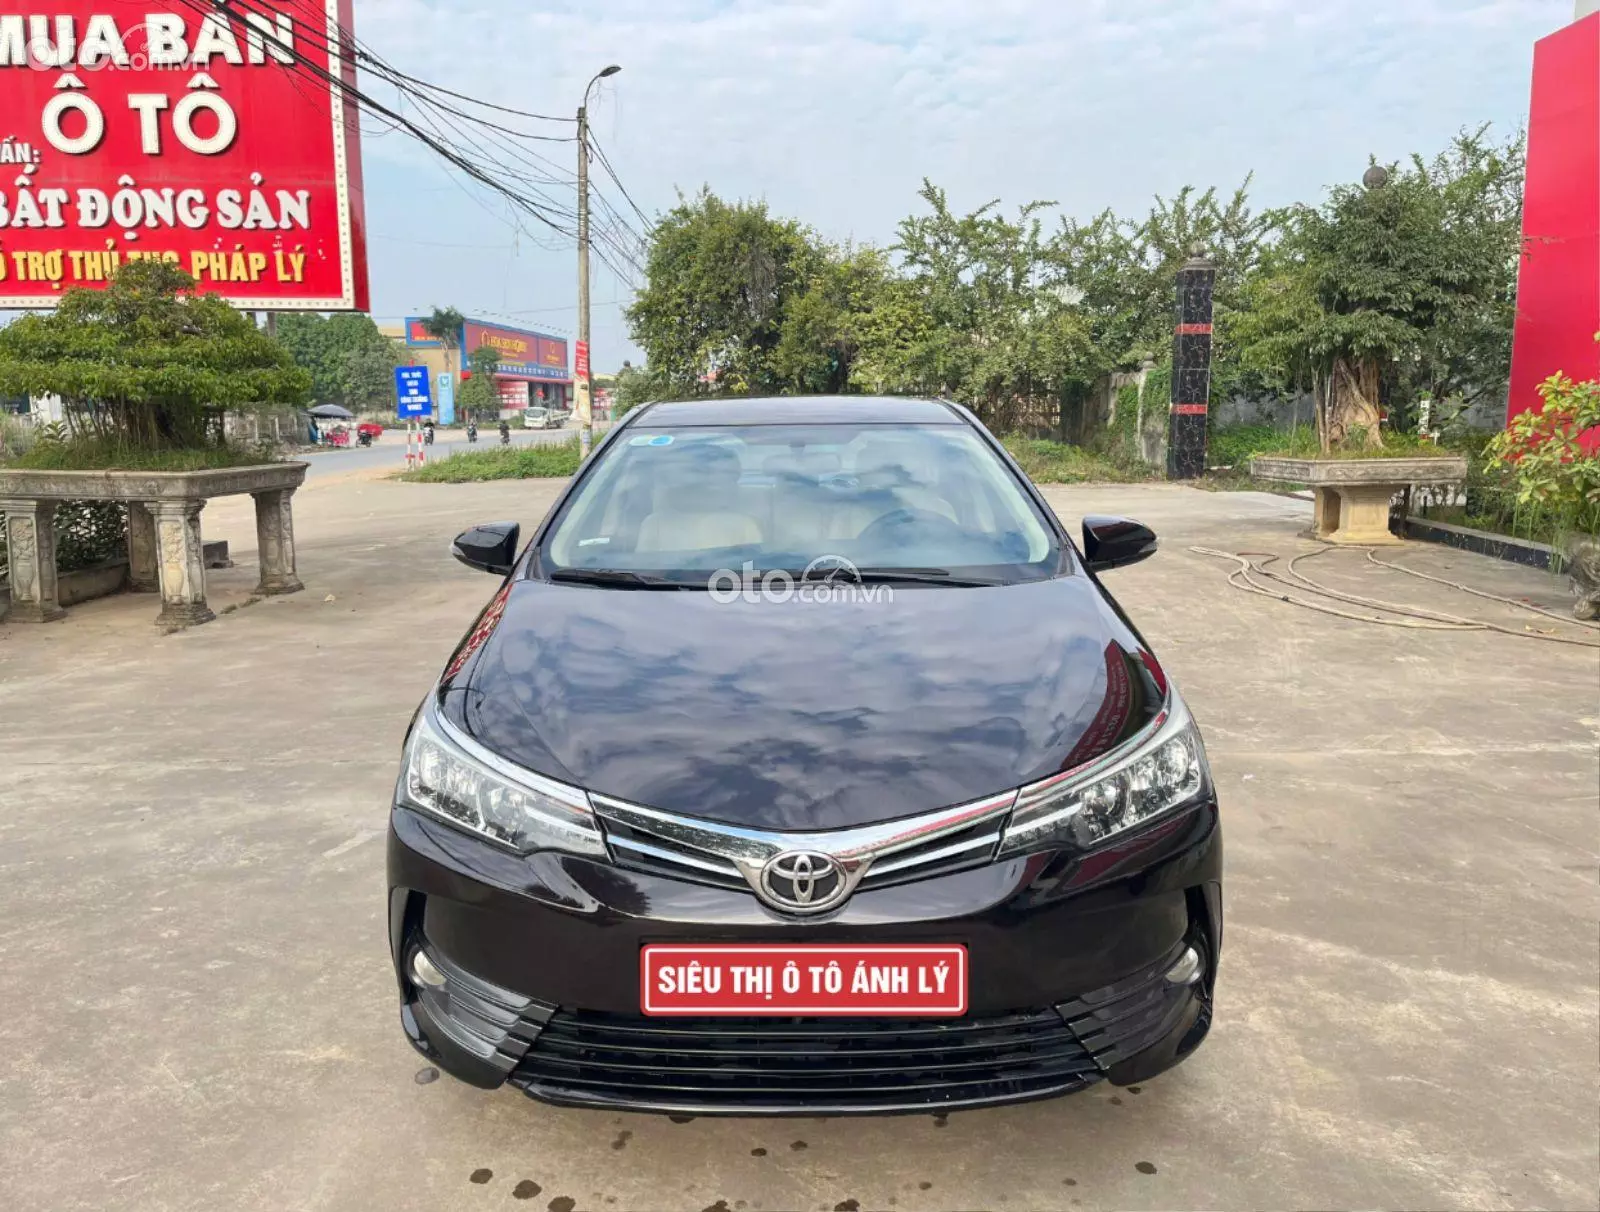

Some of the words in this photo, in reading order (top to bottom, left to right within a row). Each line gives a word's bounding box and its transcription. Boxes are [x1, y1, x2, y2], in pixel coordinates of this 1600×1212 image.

[42, 73, 104, 154] Ô
[128, 73, 236, 154] TÔ
[0, 136, 40, 163] ẤN:
[77, 174, 209, 240] ĐỘNG
[216, 172, 310, 229] SẢN
[12, 249, 64, 289] TRỢ
[191, 244, 266, 281] PHÁP
[275, 244, 305, 282] LÝ
[658, 960, 721, 993] SIÊU
[730, 966, 773, 1000] THỊ
[782, 960, 800, 993] Ô
[808, 960, 843, 993] TÔ
[851, 960, 909, 993] ÁNH
[918, 960, 950, 993] LÝ
